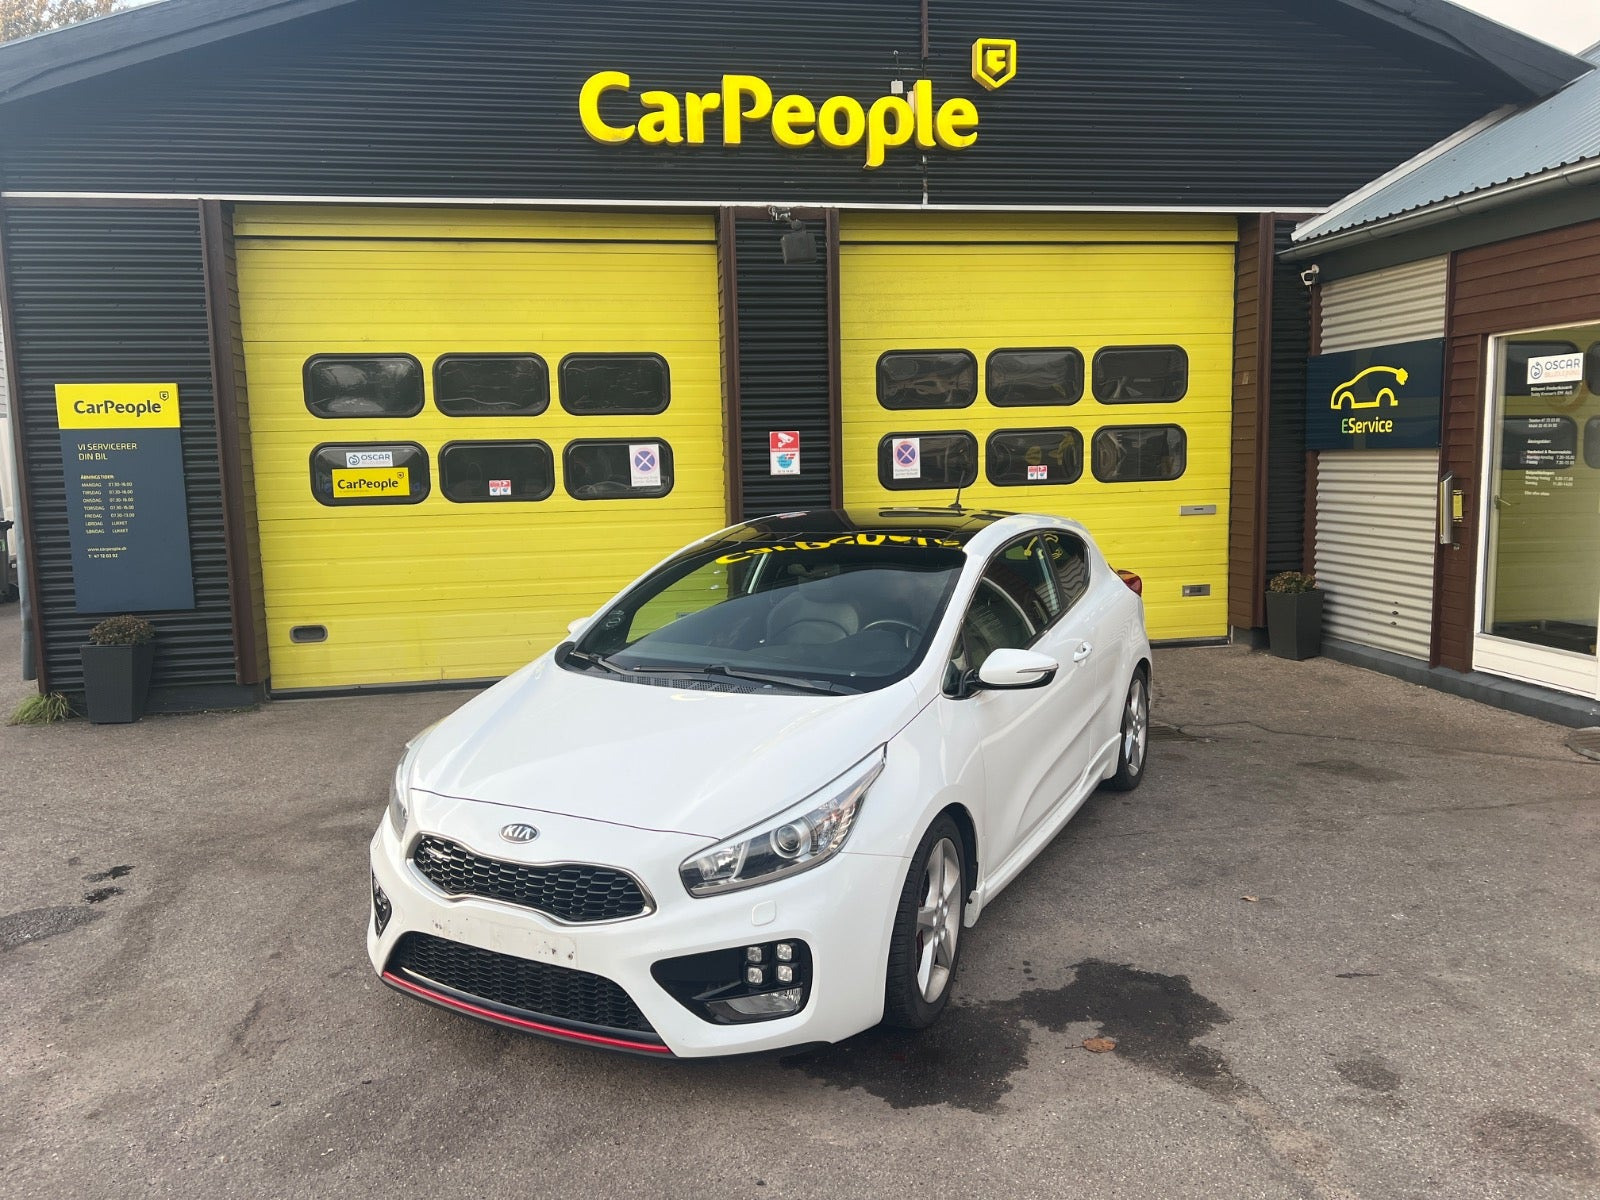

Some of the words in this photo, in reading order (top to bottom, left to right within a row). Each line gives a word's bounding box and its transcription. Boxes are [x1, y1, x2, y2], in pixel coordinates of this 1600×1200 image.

[578, 70, 979, 169] CarPeople
[1544, 358, 1581, 371] OSCAR
[73, 399, 162, 418] CarPeople
[1341, 416, 1393, 434] EService
[77, 443, 86, 451] VI
[87, 442, 138, 451] SERVICERER
[78, 452, 94, 461] DIN
[95, 452, 108, 461] BIL
[360, 453, 391, 461] OSCAR
[337, 478, 399, 491] CarPeople
[502, 825, 532, 840] KIA
